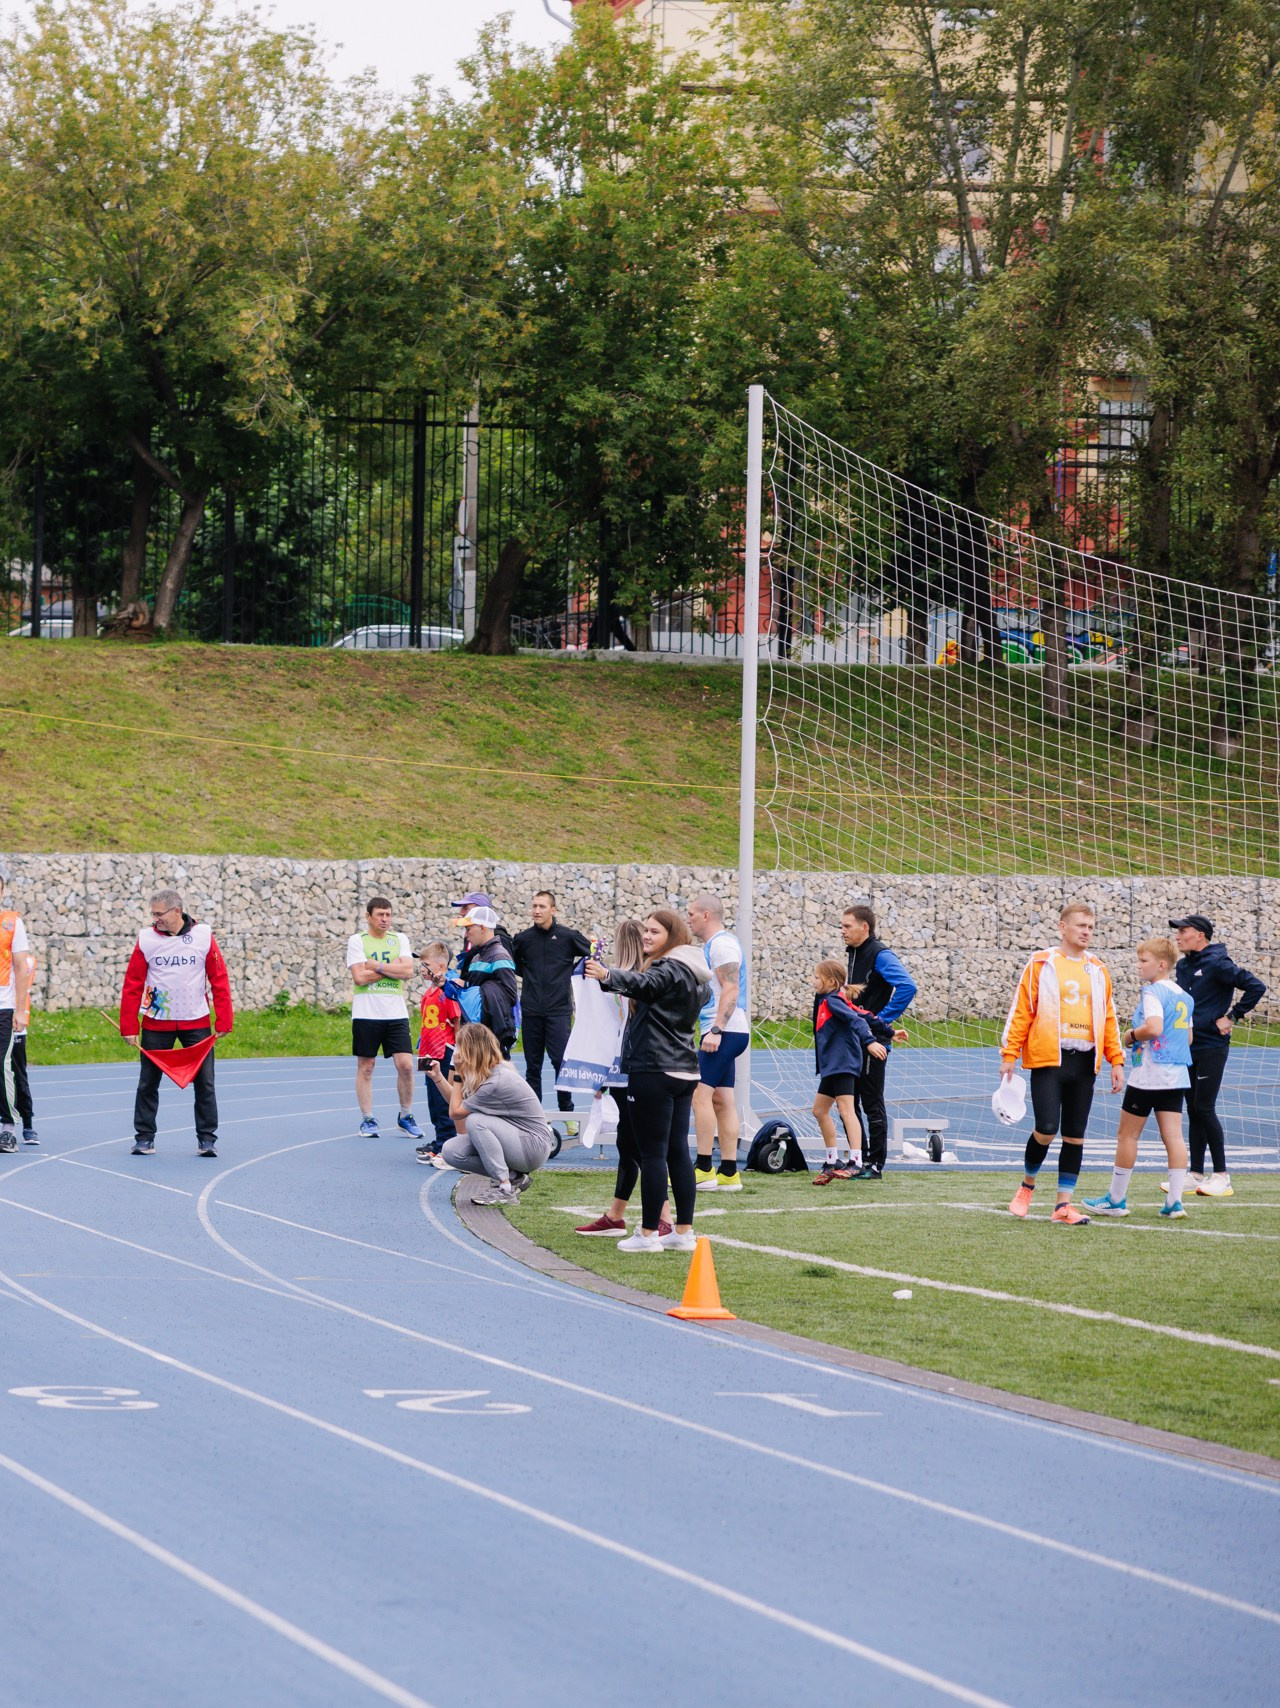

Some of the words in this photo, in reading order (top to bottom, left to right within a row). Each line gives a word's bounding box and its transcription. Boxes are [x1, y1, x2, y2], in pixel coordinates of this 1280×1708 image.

[155, 955, 196, 967] СУДЬЯ
[1063, 979, 1080, 1005] 3
[1082, 994, 1088, 1007] 1
[1173, 1001, 1189, 1029] 2
[7, 1385, 160, 1410] 3
[362, 1389, 533, 1415] 2
[713, 1391, 884, 1417] 1
